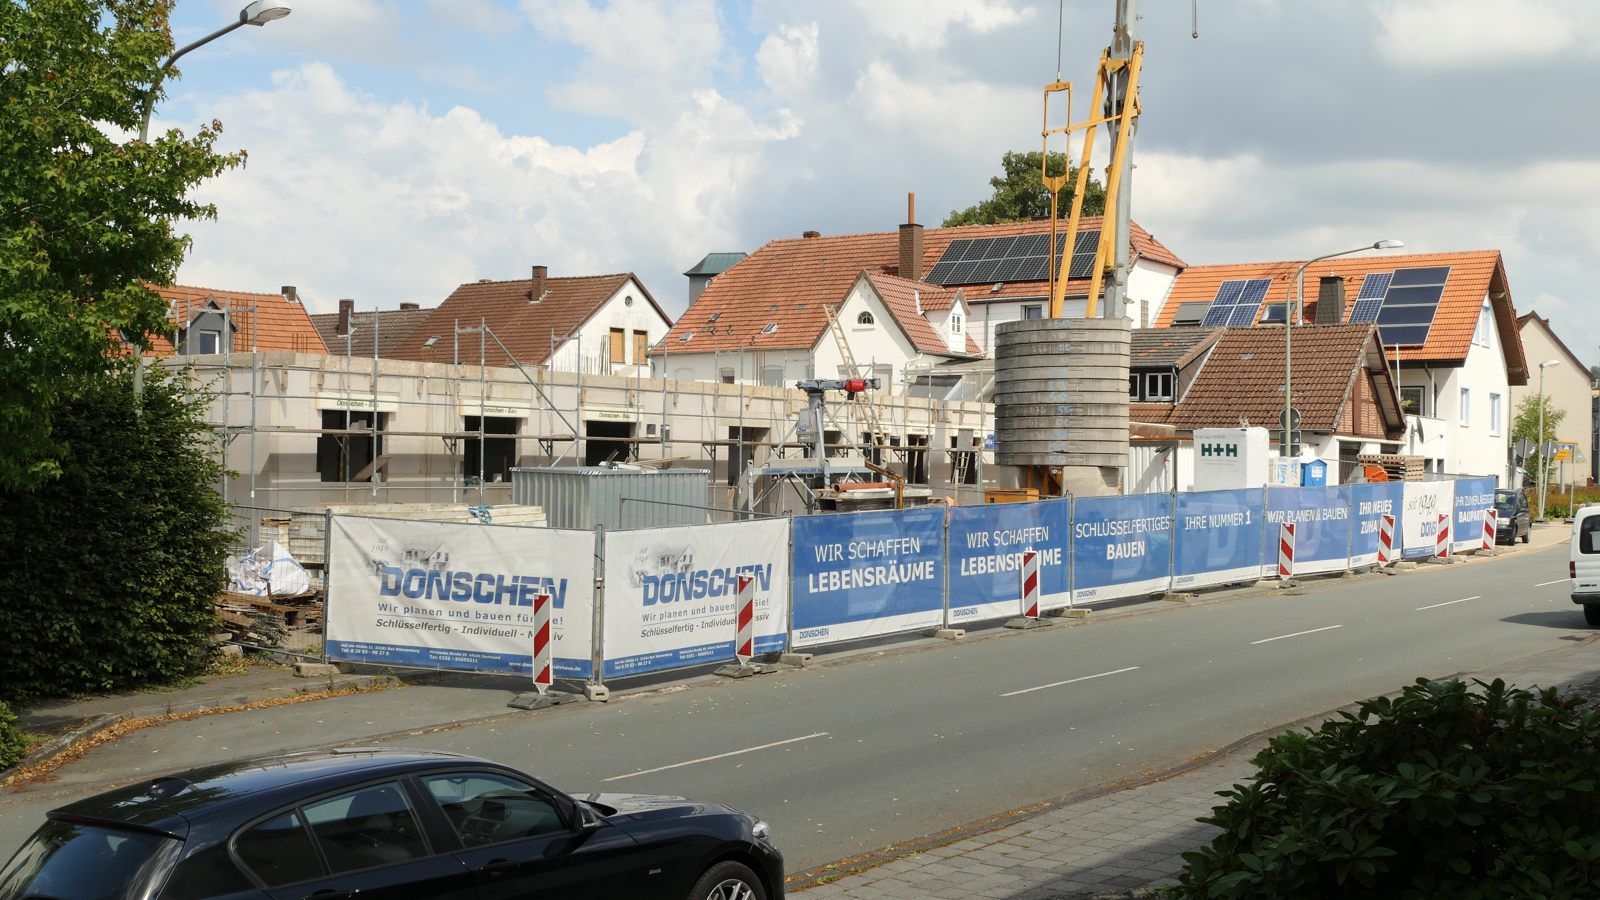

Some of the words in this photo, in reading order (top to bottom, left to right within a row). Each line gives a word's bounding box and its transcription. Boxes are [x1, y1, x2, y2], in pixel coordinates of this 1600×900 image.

[1201, 443, 1237, 457] H+H
[1267, 510, 1285, 523] WIR
[1287, 509, 1315, 523] PLANEN
[1322, 507, 1348, 521] BAUEN
[1359, 501, 1371, 515] IHR
[1373, 500, 1392, 513] NEUES
[1075, 516, 1171, 538] SCHLÜSSELFERTIGES
[1185, 515, 1207, 530] IHRE
[1208, 512, 1244, 528] NUMMER
[1245, 509, 1252, 525] 1
[1361, 520, 1378, 535] ZUHA
[966, 532, 990, 549] WIR
[993, 526, 1049, 547] SCHAFFEN
[815, 544, 844, 562] WIR
[848, 537, 921, 560] SCHAFFEN
[1106, 540, 1146, 560] BAUEN
[808, 560, 935, 593] LEBENSRÄUME
[378, 603, 399, 612] Wir
[403, 606, 442, 616] planen
[448, 610, 470, 618] und
[475, 611, 512, 621] bauen
[642, 613, 657, 622] Wir
[659, 608, 688, 620] planen
[691, 605, 706, 615] und
[709, 602, 735, 613] bauen
[376, 618, 451, 634] Schlüsselfertig
[461, 625, 517, 638] Individuell
[641, 623, 694, 638] Schlüsselfertig
[701, 616, 737, 629] Individuel
